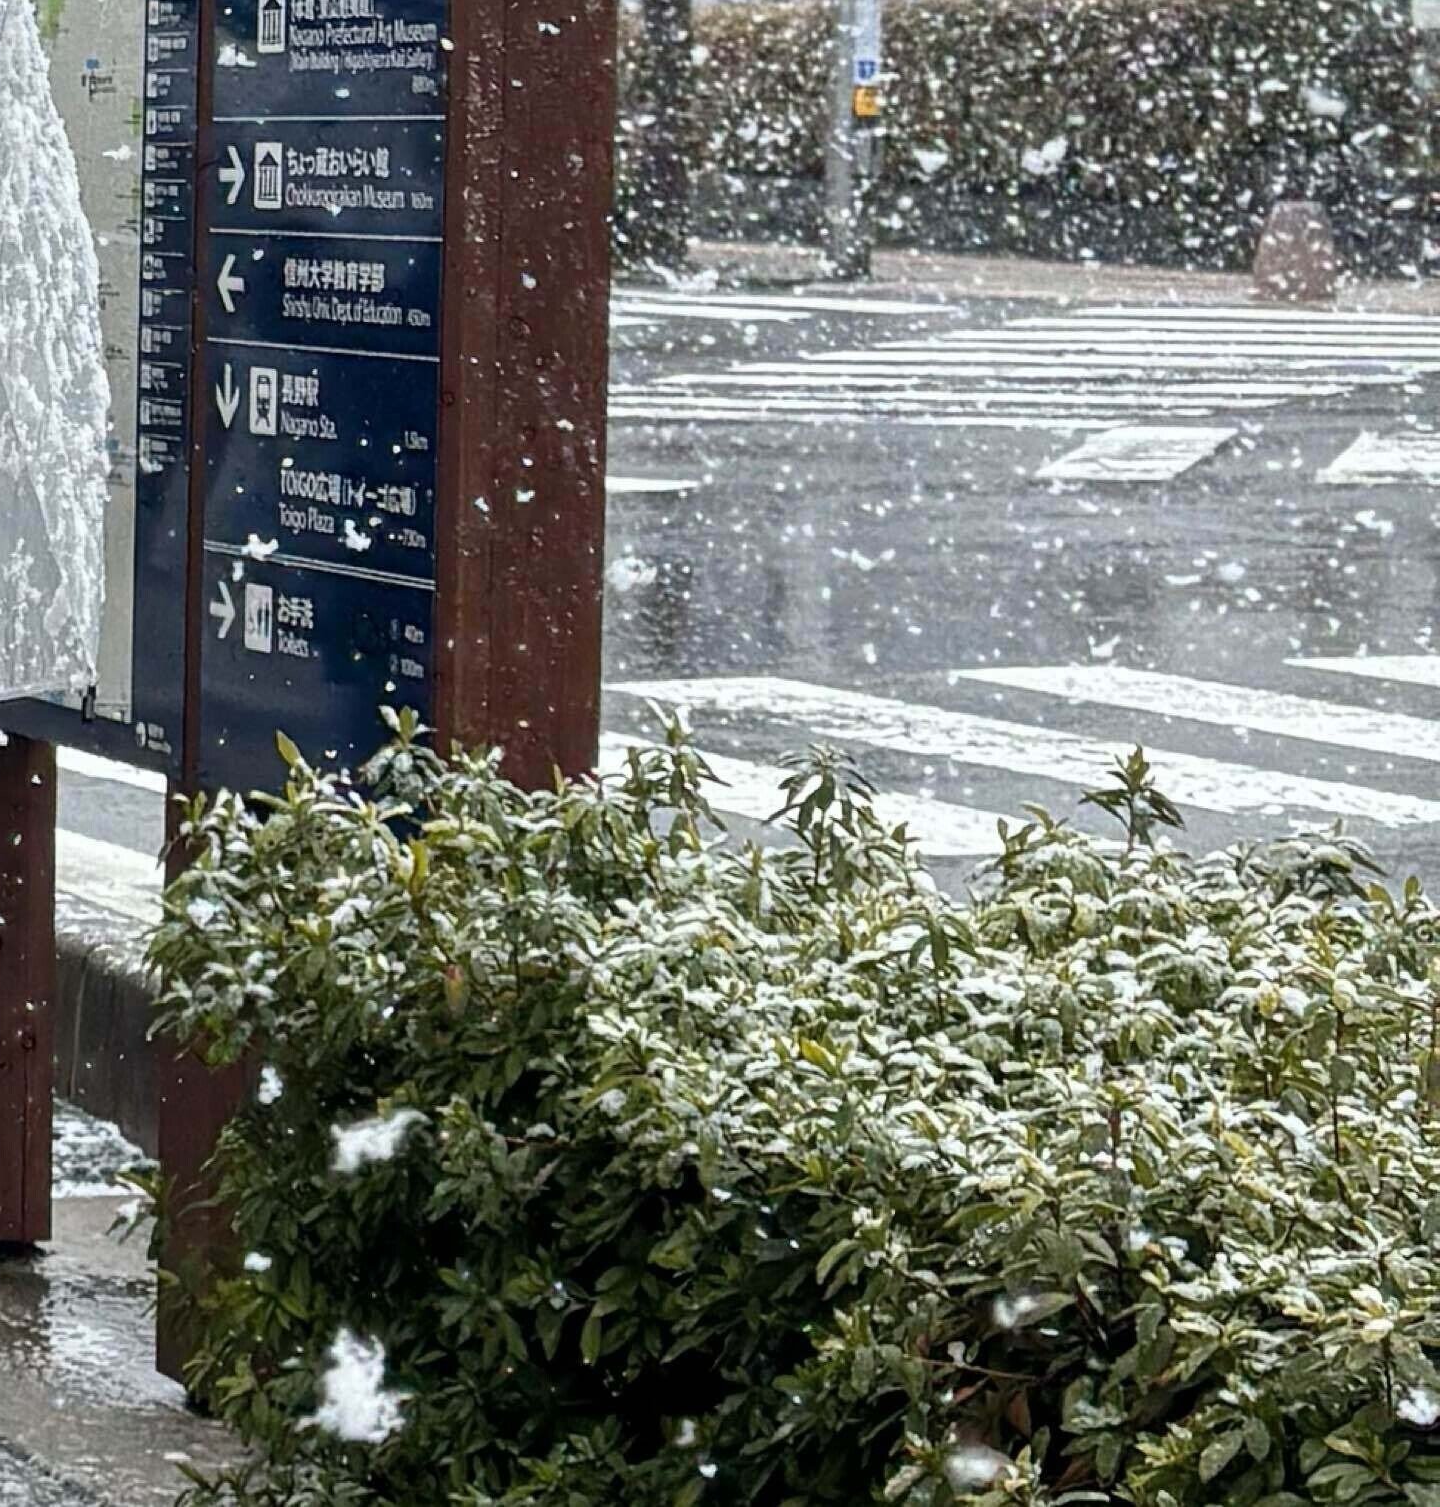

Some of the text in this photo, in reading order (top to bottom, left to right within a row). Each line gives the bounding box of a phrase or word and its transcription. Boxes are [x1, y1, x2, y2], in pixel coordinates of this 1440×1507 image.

[284, 257, 385, 293] 信州大学教育学部
[281, 374, 320, 407] 長野駅
[280, 409, 318, 438] Nagano
[279, 501, 306, 535] Toigo
[308, 506, 335, 534] Plaza
